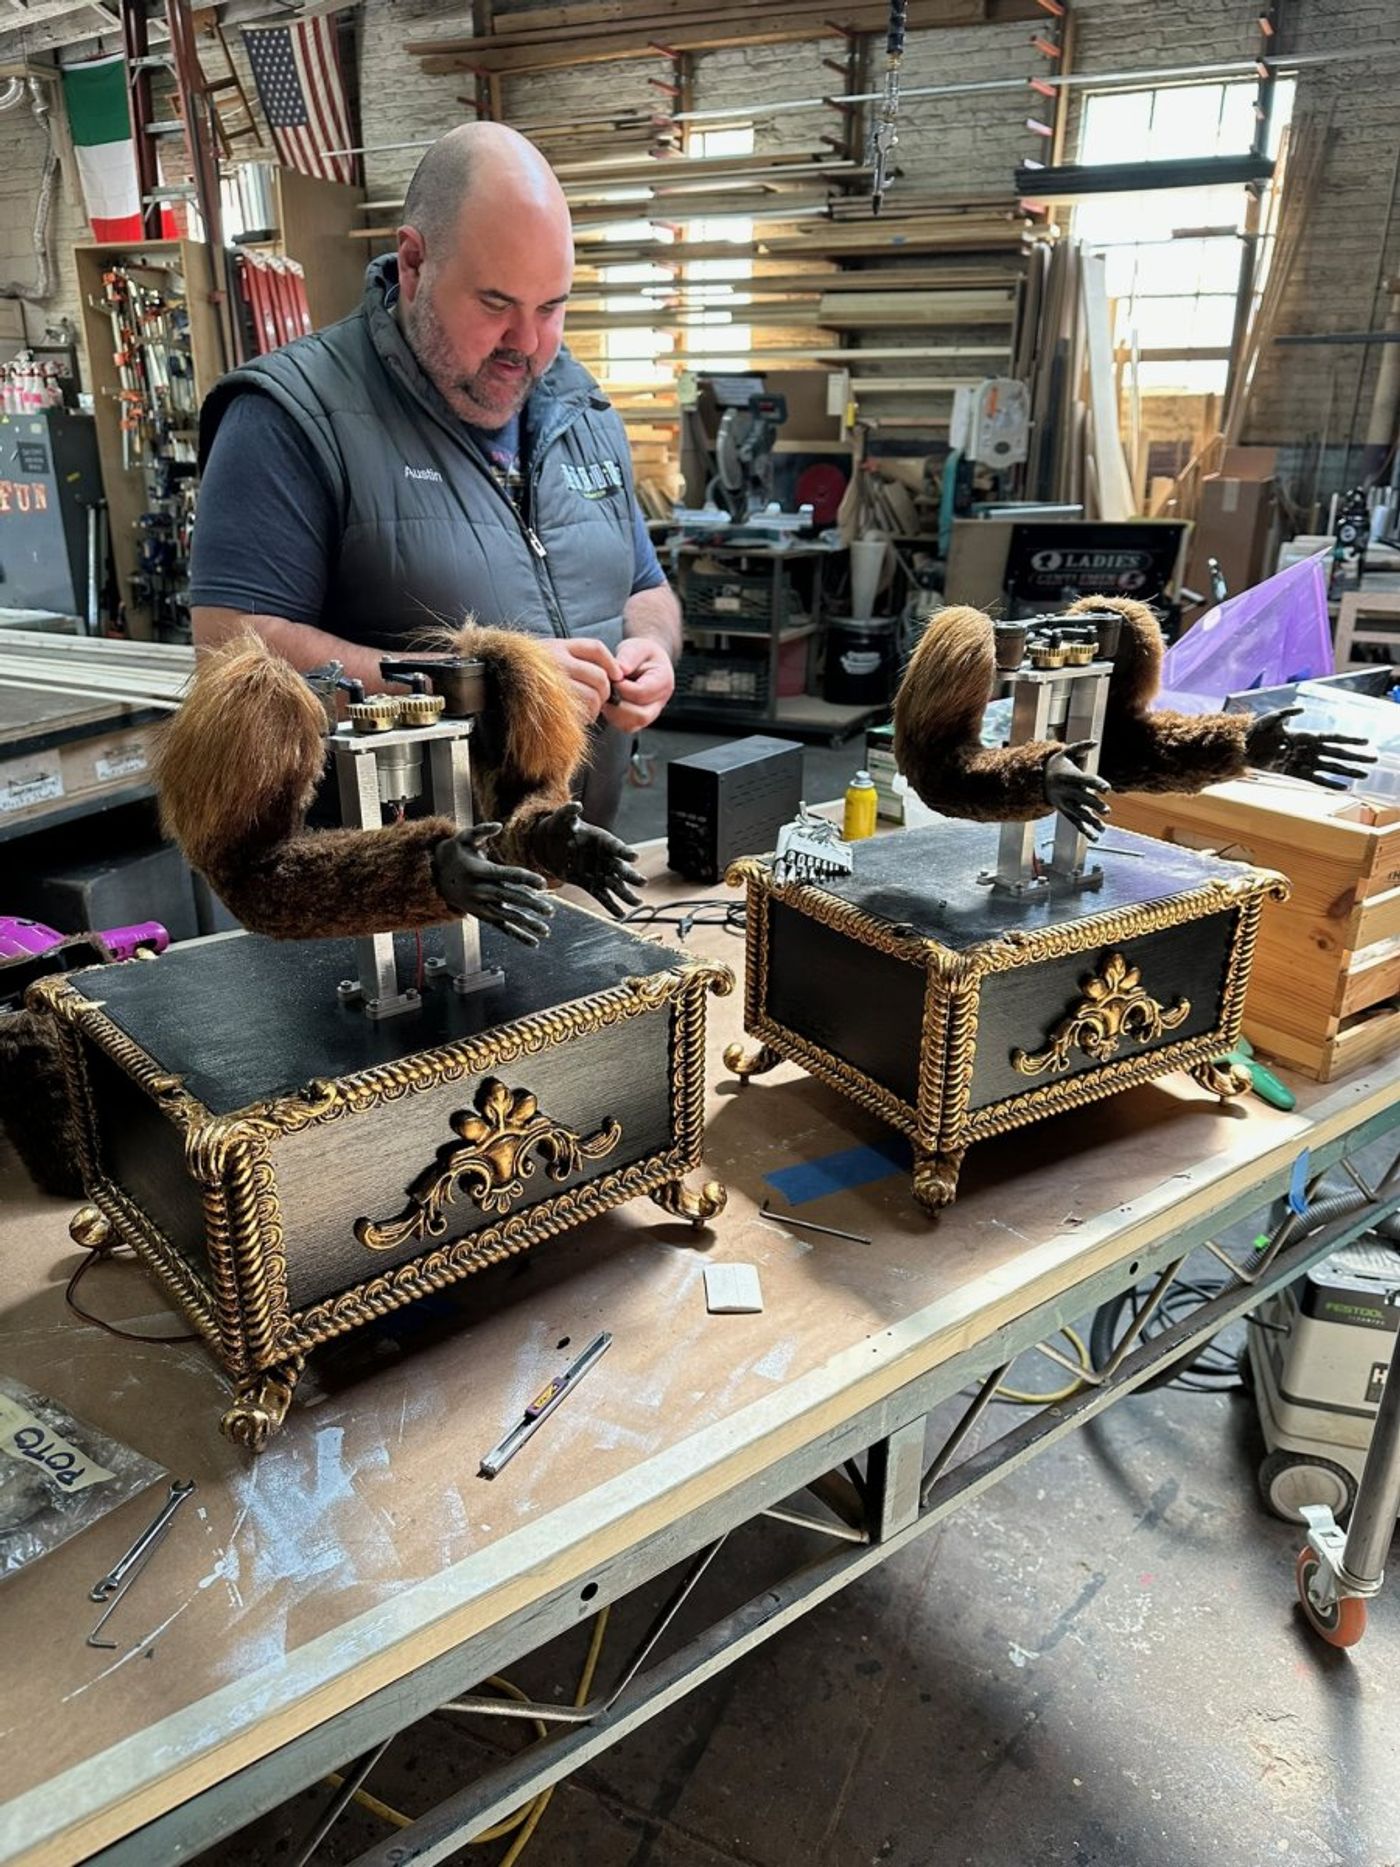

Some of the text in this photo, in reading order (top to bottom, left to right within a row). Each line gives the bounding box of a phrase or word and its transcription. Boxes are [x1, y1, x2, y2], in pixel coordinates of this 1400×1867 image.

[404, 465, 443, 482] Austin
[0, 481, 47, 511] FUN
[1065, 554, 1141, 568] LADIES
[1326, 1302, 1384, 1319] FESTOOL
[14, 1427, 85, 1486] POTO
